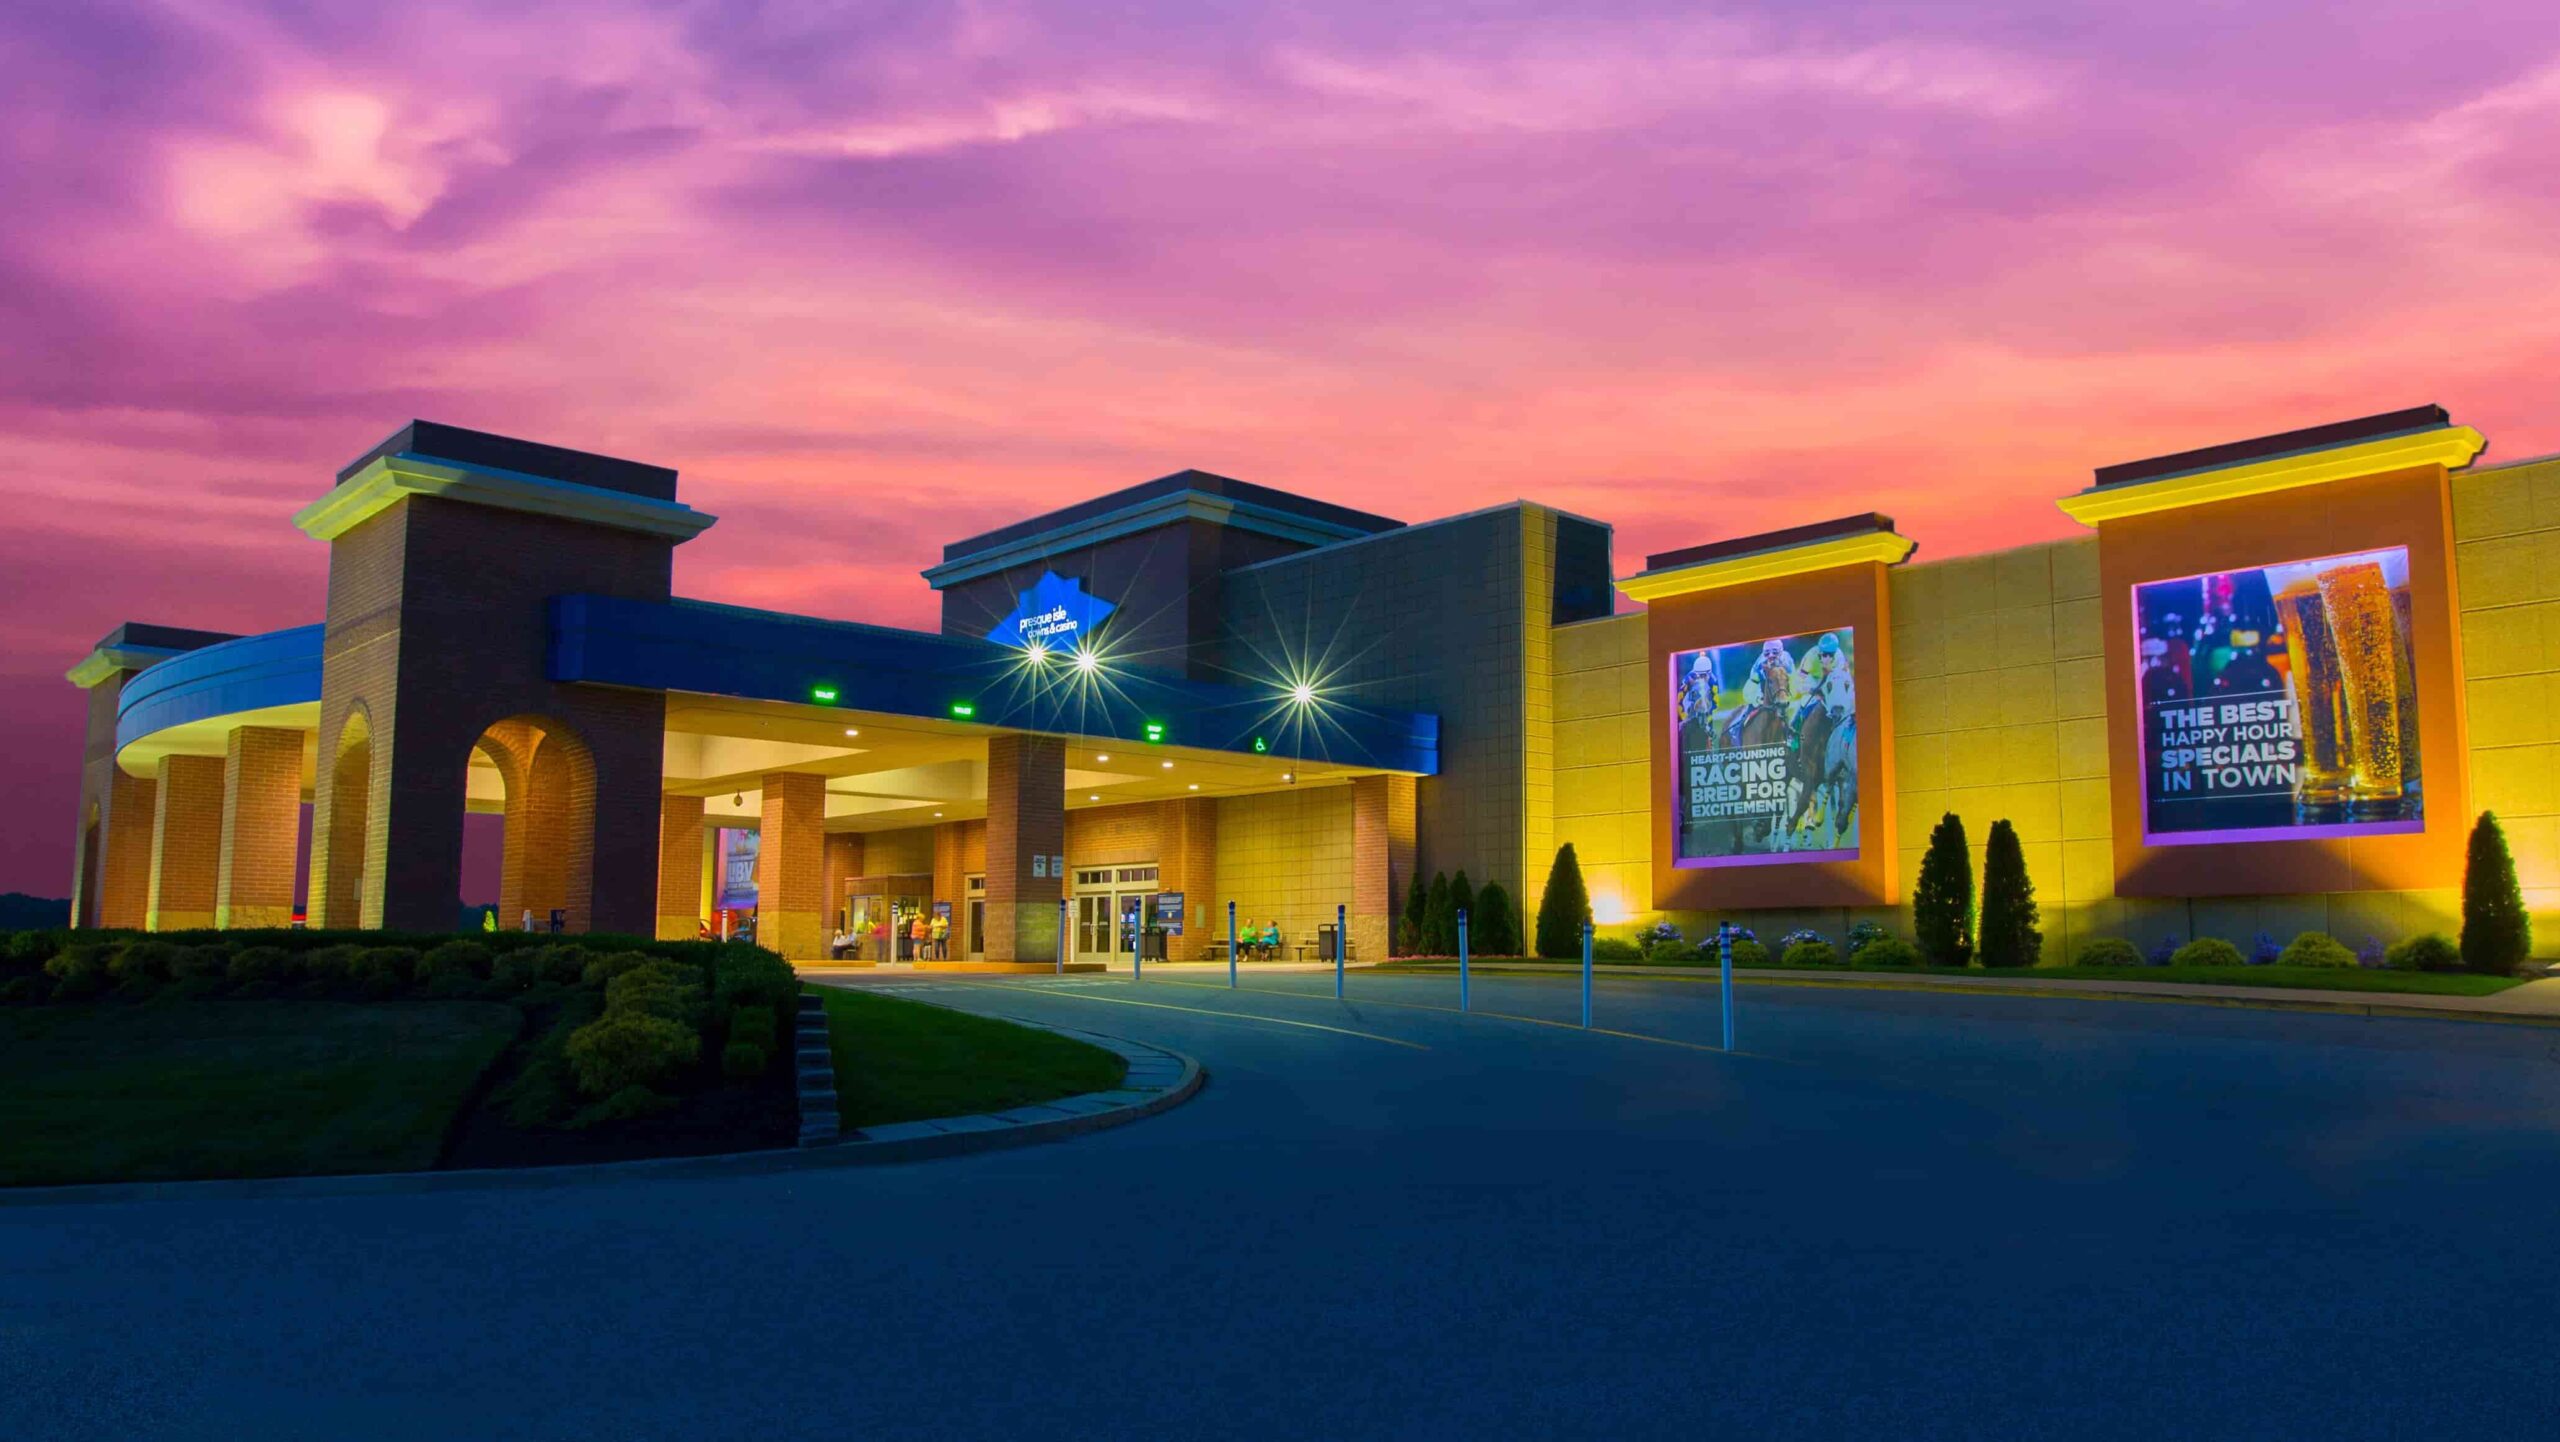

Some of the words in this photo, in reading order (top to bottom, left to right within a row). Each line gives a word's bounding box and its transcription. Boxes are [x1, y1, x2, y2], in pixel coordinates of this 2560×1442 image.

[1020, 612, 1053, 633] presque
[1053, 604, 1067, 621] isle
[2160, 706, 2215, 729] THE
[2220, 700, 2292, 725] BEST
[2162, 727, 2228, 747] HAPPY
[2233, 722, 2293, 742] HOUR
[1690, 746, 1786, 766] HEART-POUNDING
[2161, 740, 2296, 769] SPECIALS
[1690, 758, 1787, 787] RACING
[2163, 770, 2192, 792] IN
[2202, 763, 2296, 789] TOWN
[1691, 785, 1742, 804] BRED
[1745, 780, 1786, 799] FOR
[1691, 798, 1787, 818] EXCITEMENT
